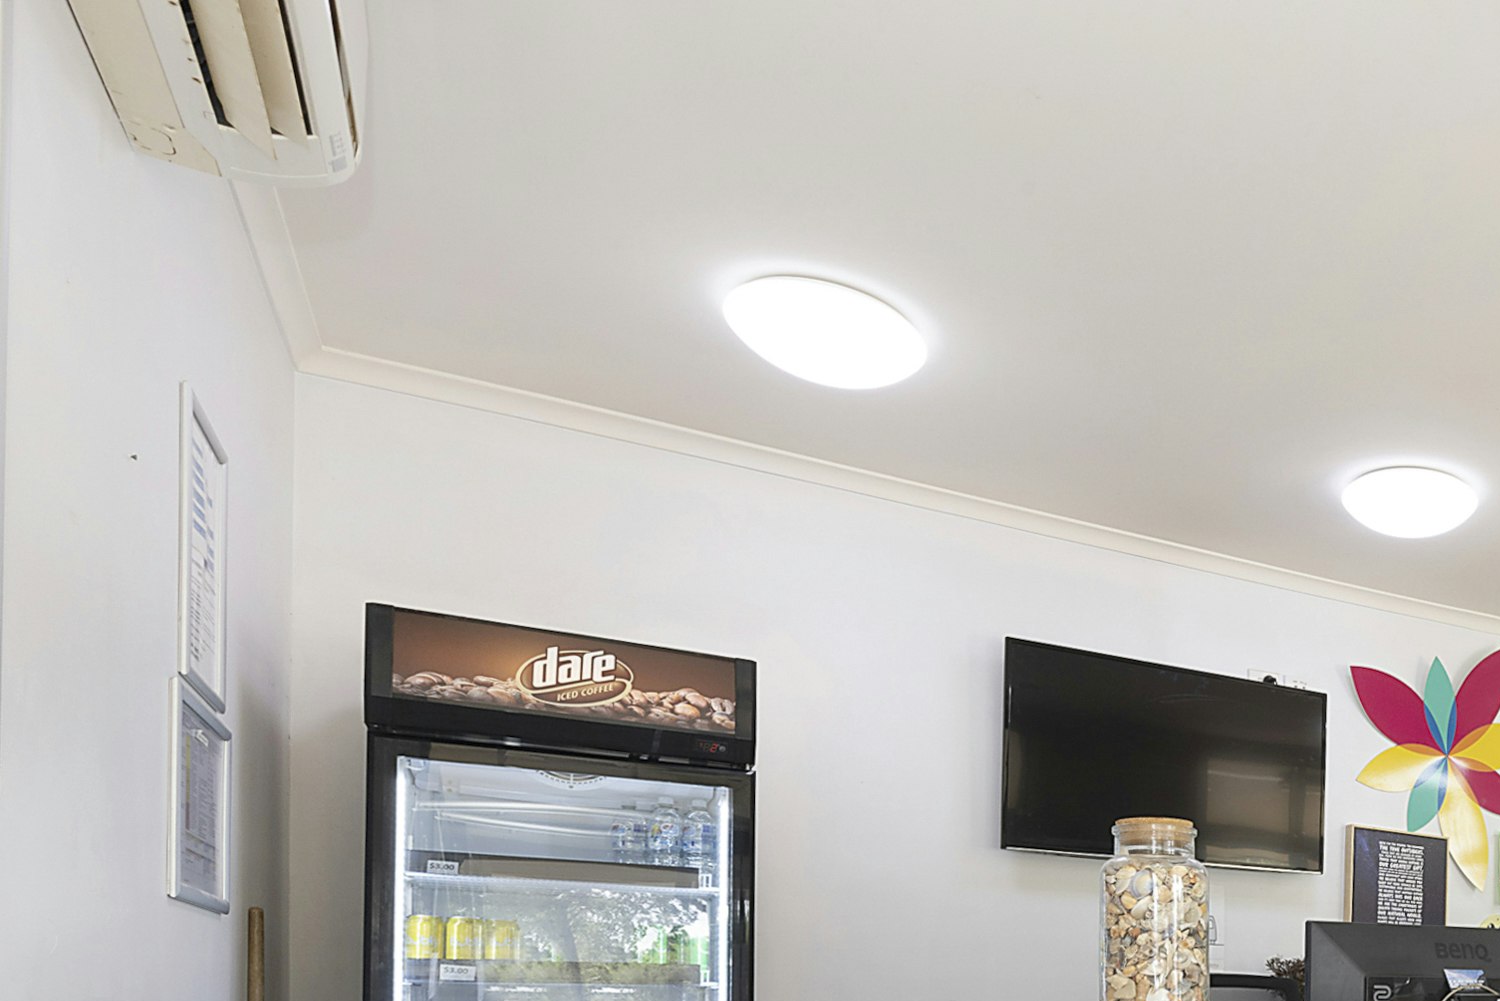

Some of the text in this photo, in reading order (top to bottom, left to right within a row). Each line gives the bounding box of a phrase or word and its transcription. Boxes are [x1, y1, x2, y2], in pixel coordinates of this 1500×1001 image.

[532, 646, 617, 689] dare
[557, 683, 615, 702] ICED COFFEE
[429, 862, 455, 871] $3.00
